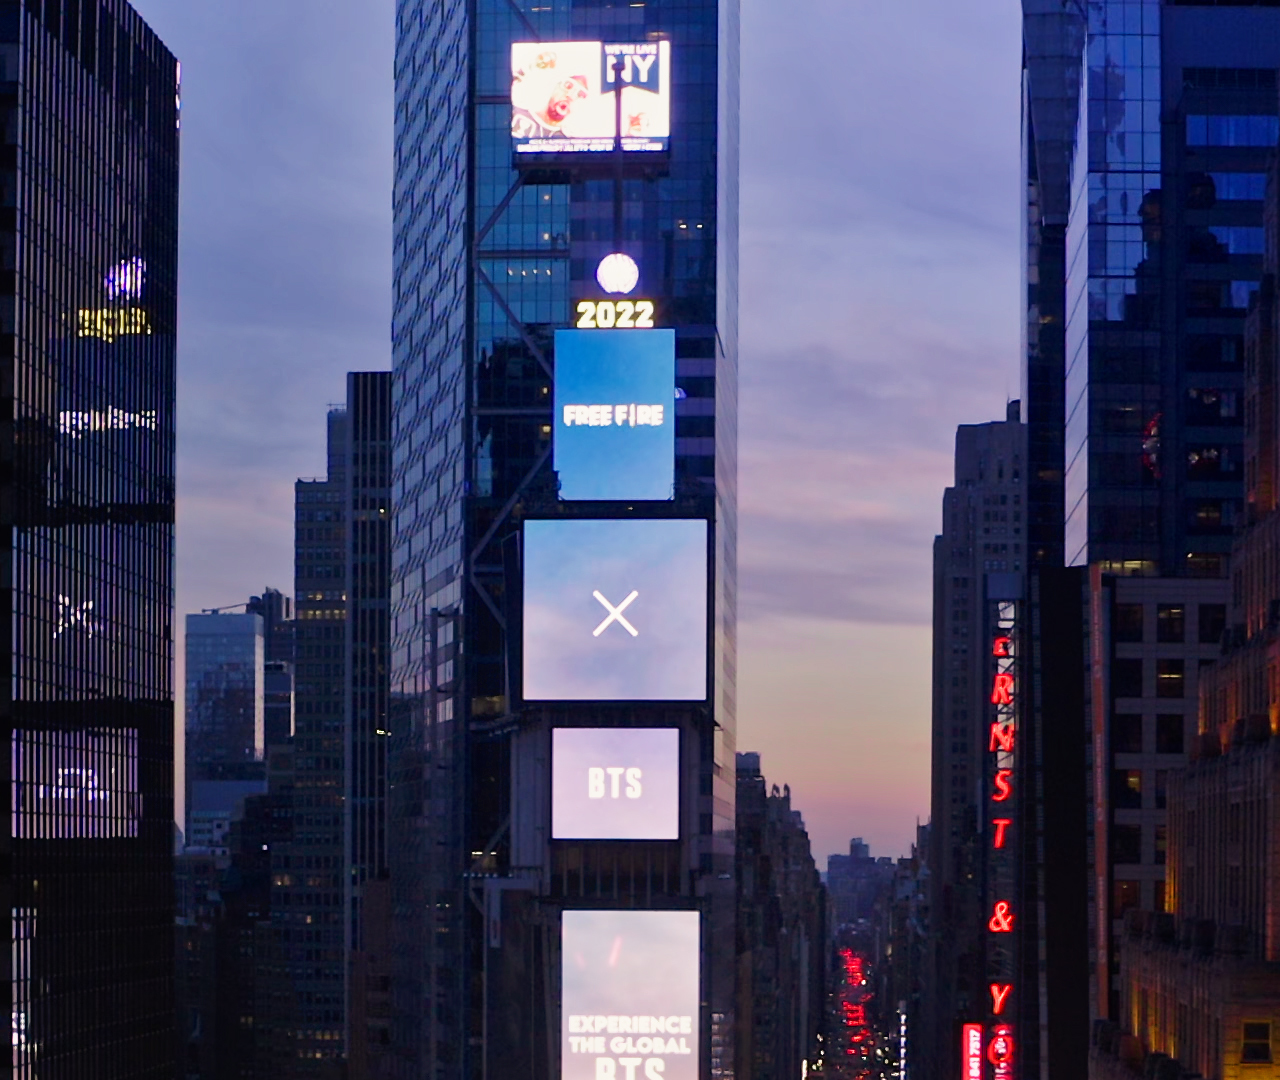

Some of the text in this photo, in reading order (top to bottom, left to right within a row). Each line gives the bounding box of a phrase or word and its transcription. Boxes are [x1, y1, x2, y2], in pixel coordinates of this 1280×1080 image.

[606, 55, 656, 83] NY
[576, 301, 654, 328] 2022
[563, 403, 664, 428] FREE FIRE
[588, 767, 642, 799] BTS
[988, 900, 1015, 933] &
[568, 1015, 692, 1034] EXPERIENCE
[568, 1036, 691, 1054] THE GLOBAL
